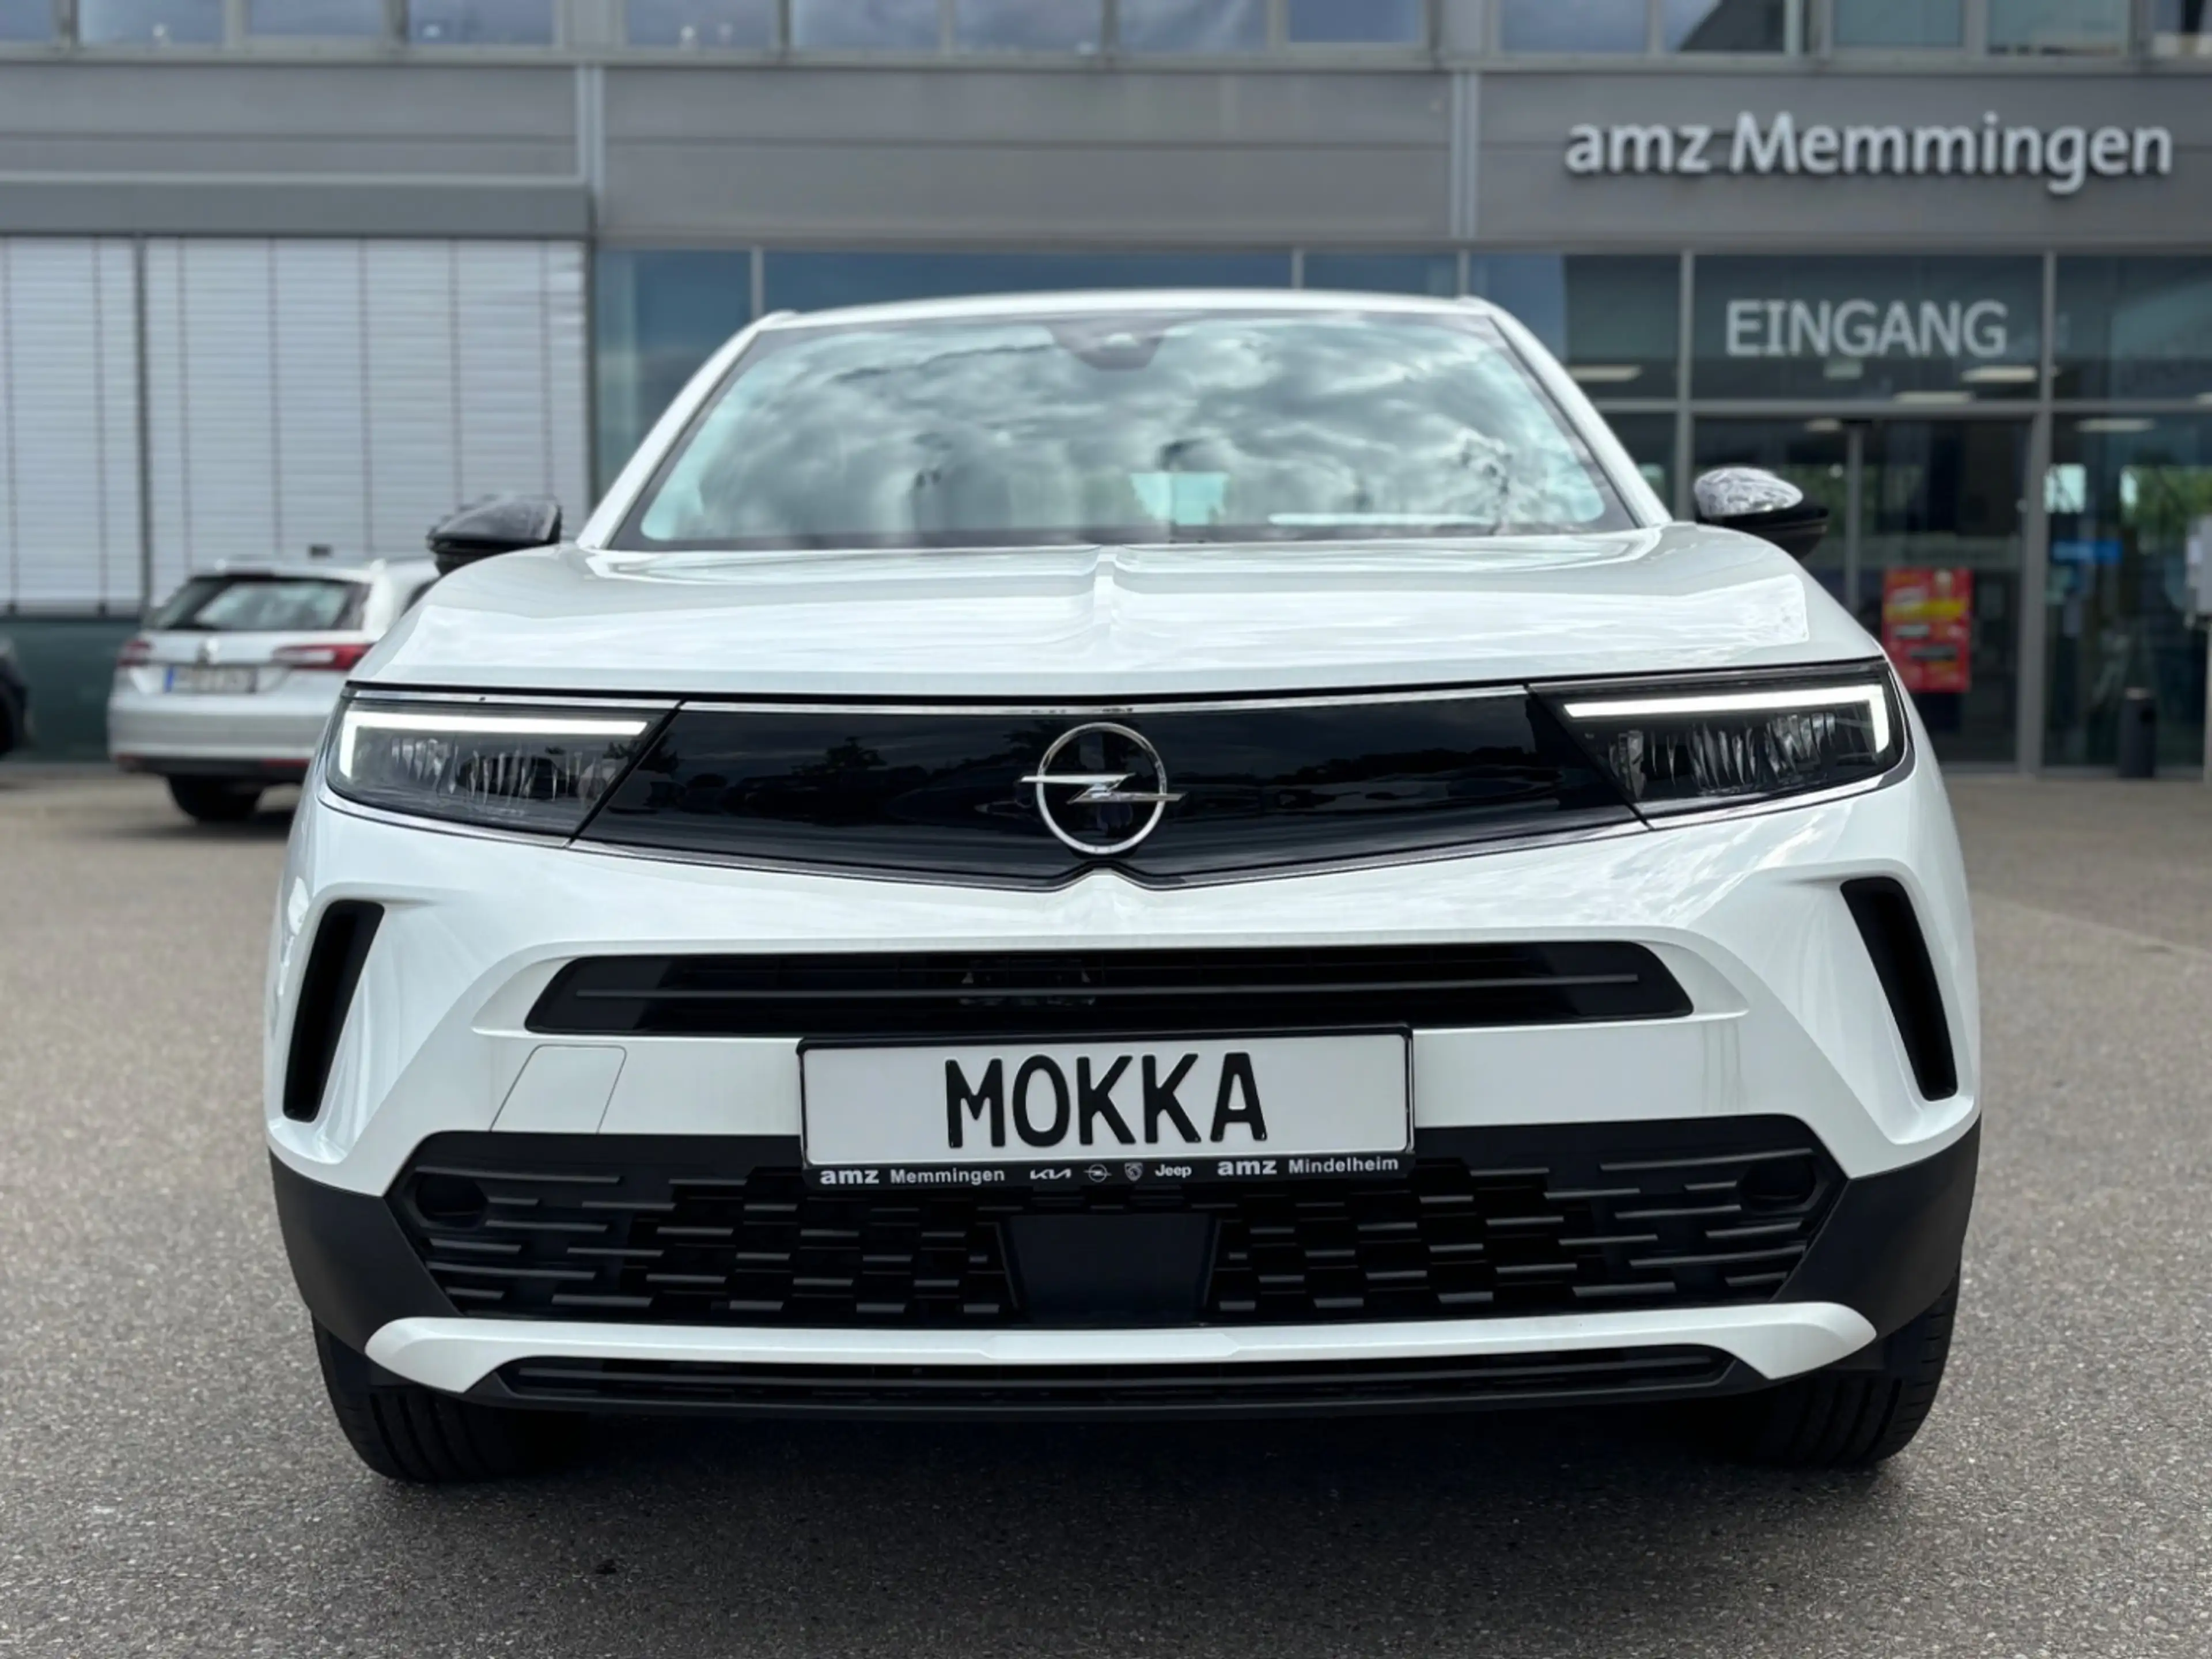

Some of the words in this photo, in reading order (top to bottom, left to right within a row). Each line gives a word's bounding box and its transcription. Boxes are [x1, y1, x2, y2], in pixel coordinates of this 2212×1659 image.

[1565, 123, 1711, 172] amz
[1730, 111, 2172, 193] Memmingen
[1725, 299, 2009, 358] EINGANG
[944, 1052, 1268, 1149] MOKKA
[820, 1170, 880, 1184] amz
[890, 1168, 1005, 1185] Memmingen
[1154, 1164, 1192, 1178] Jeep
[1217, 1160, 1278, 1176] amz
[1288, 1157, 1399, 1174] Mindelheim
